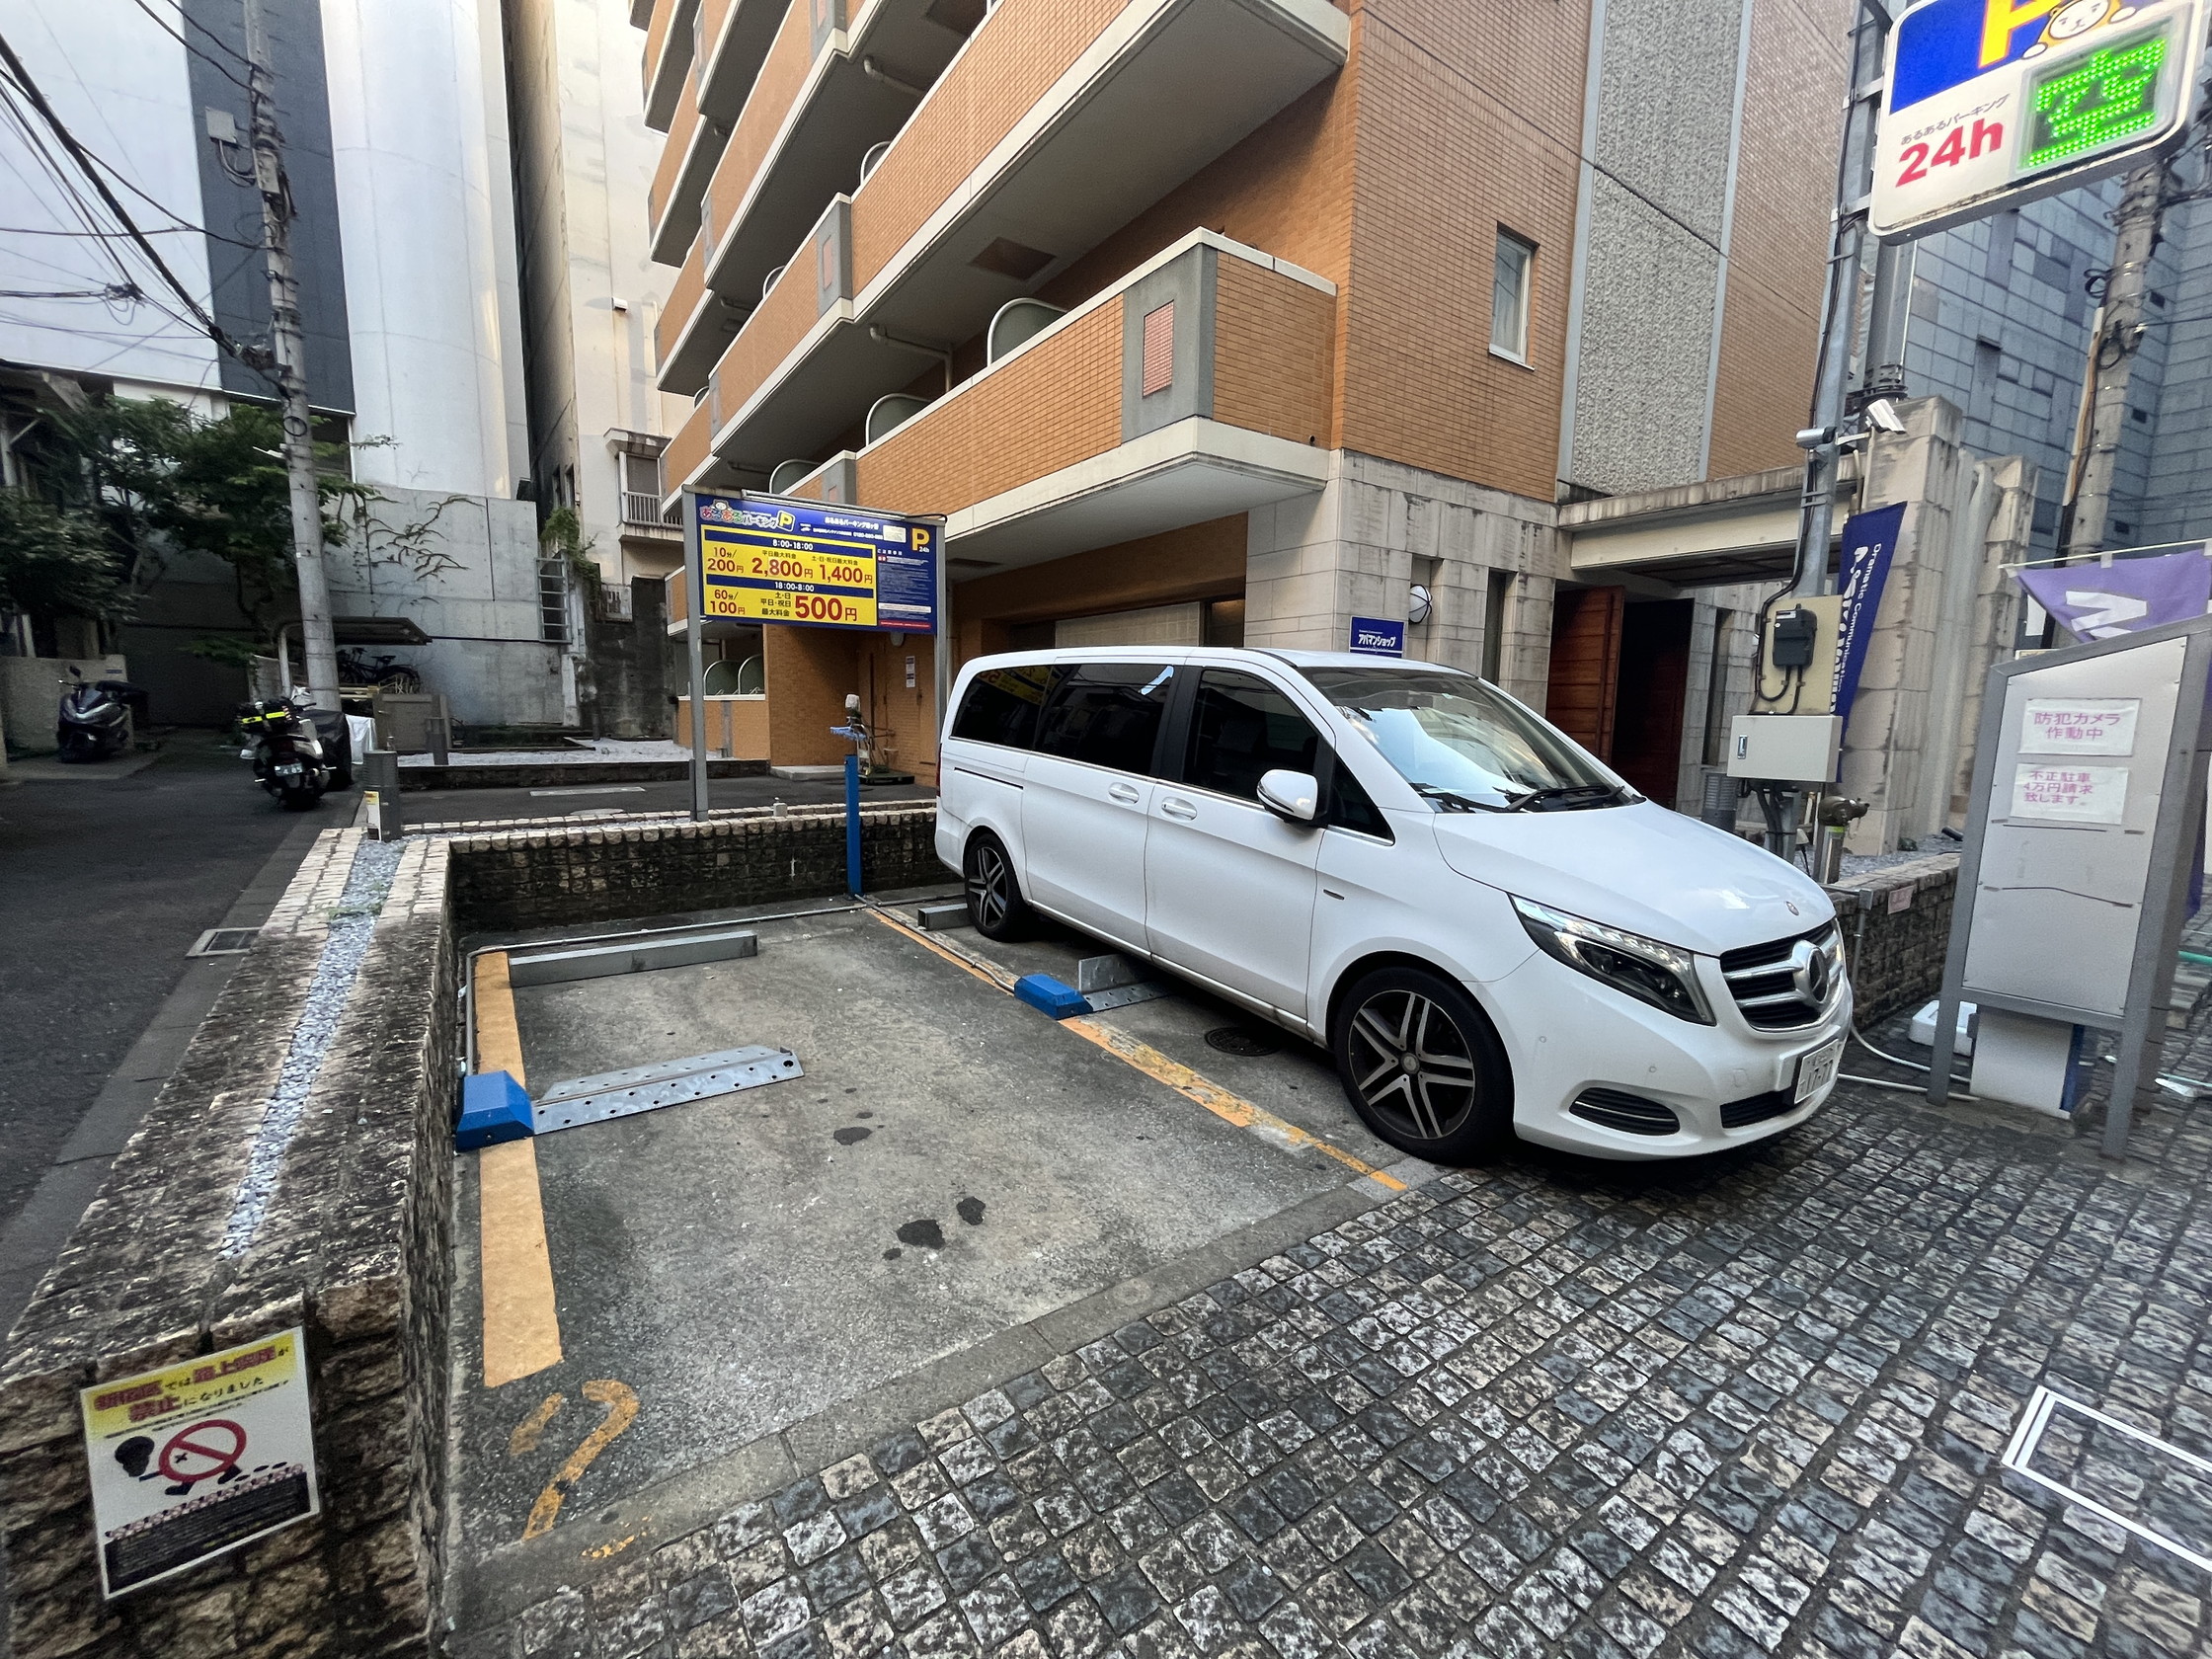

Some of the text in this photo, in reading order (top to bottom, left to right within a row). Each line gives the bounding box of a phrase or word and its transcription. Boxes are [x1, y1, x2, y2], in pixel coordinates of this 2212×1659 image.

[2028, 39, 2166, 167] 空
[1901, 94, 2011, 145] あるあるパーキング
[1895, 118, 2004, 188] 24h
[772, 539, 814, 550] 8:00-18:00
[911, 527, 930, 551] P
[762, 550, 797, 559] 平日最大料金
[707, 557, 745, 574] 200円
[751, 557, 814, 579] 2,800円
[1857, 543, 1882, 599] Dramatic
[820, 564, 873, 585] 1,400円
[774, 581, 815, 592] 18:00-8:00
[710, 600, 746, 615] 100円
[761, 608, 791, 617] 最大料金
[795, 595, 857, 622] 500円
[1358, 633, 1396, 648] アパマンショップ
[2034, 712, 2121, 726] 防犯カメラ
[2046, 727, 2103, 741] 作動中
[2029, 770, 2092, 783] 不正駐車
[2022, 782, 2094, 795] 4万円請求
